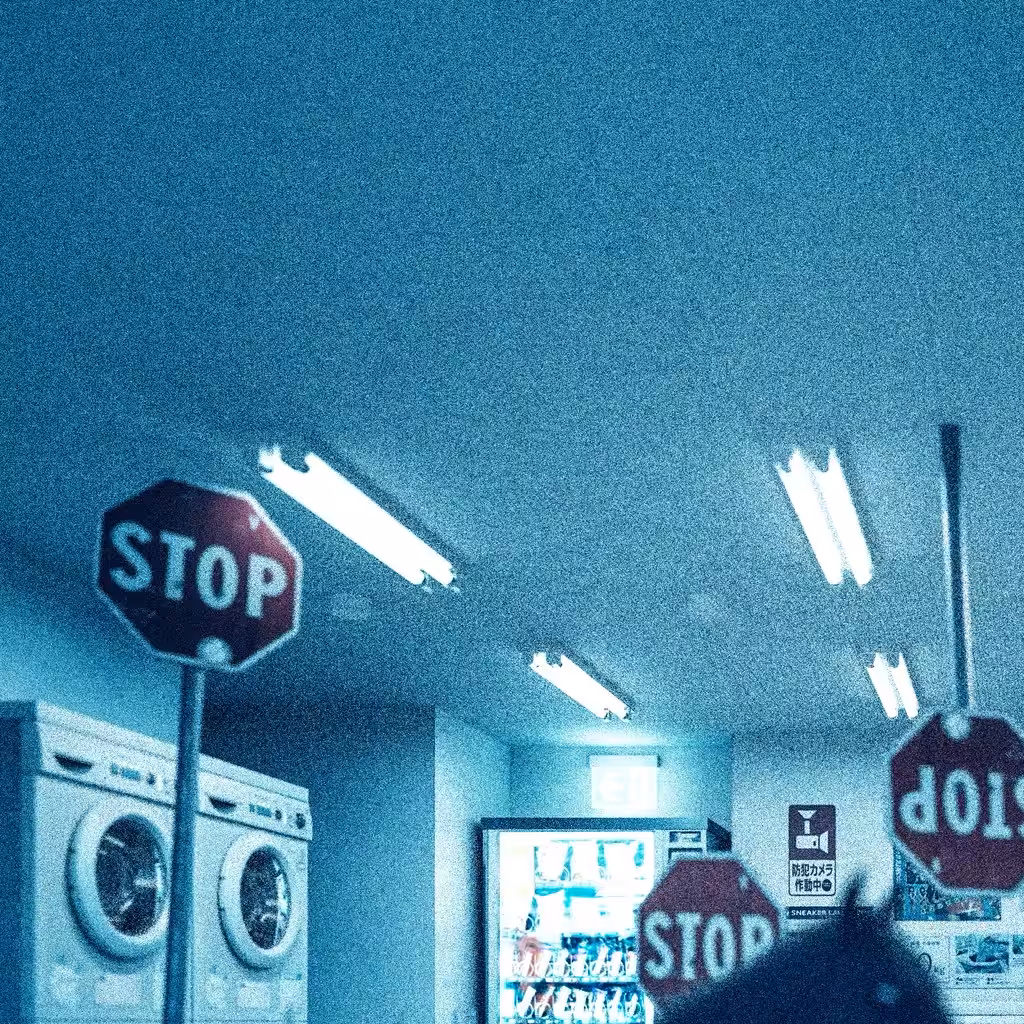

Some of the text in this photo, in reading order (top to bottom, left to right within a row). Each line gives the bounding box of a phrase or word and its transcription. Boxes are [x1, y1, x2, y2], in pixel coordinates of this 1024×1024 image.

[109, 520, 288, 619] STOP
[792, 863, 833, 877] 防犯カメラ
[795, 878, 821, 892] 作動中
[643, 911, 775, 981] STOP
